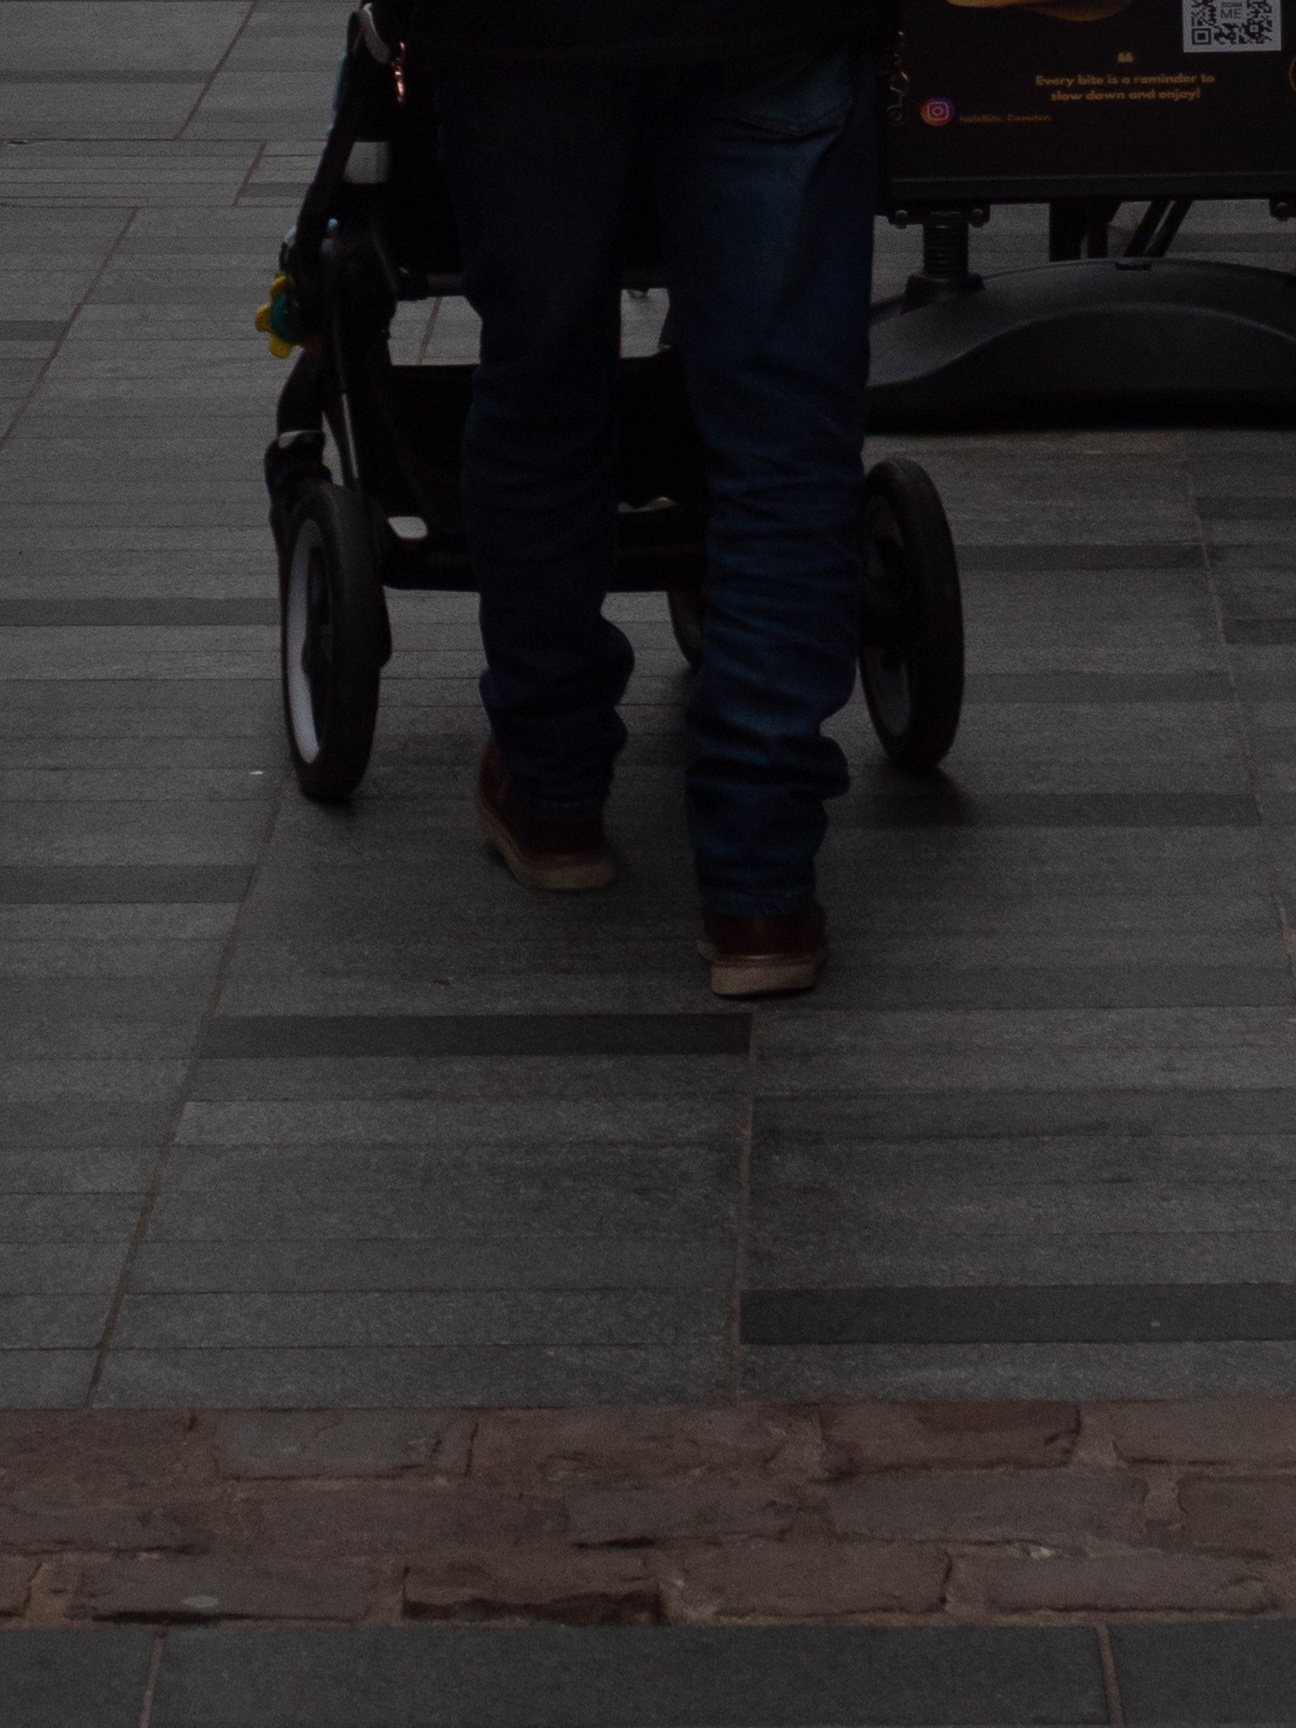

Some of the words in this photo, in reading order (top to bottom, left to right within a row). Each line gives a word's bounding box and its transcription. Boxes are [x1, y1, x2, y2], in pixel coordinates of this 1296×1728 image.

[1220, 8, 1242, 20] ME
[1035, 75, 1075, 89] Every
[1077, 73, 1105, 86] bite
[1107, 74, 1118, 85] is
[1121, 76, 1131, 85] a
[1133, 72, 1197, 85] reminder
[1200, 73, 1216, 84] to
[1050, 90, 1083, 102] slow
[1085, 89, 1126, 101] down
[1128, 88, 1155, 100] and
[1158, 87, 1202, 102] enjoy!
